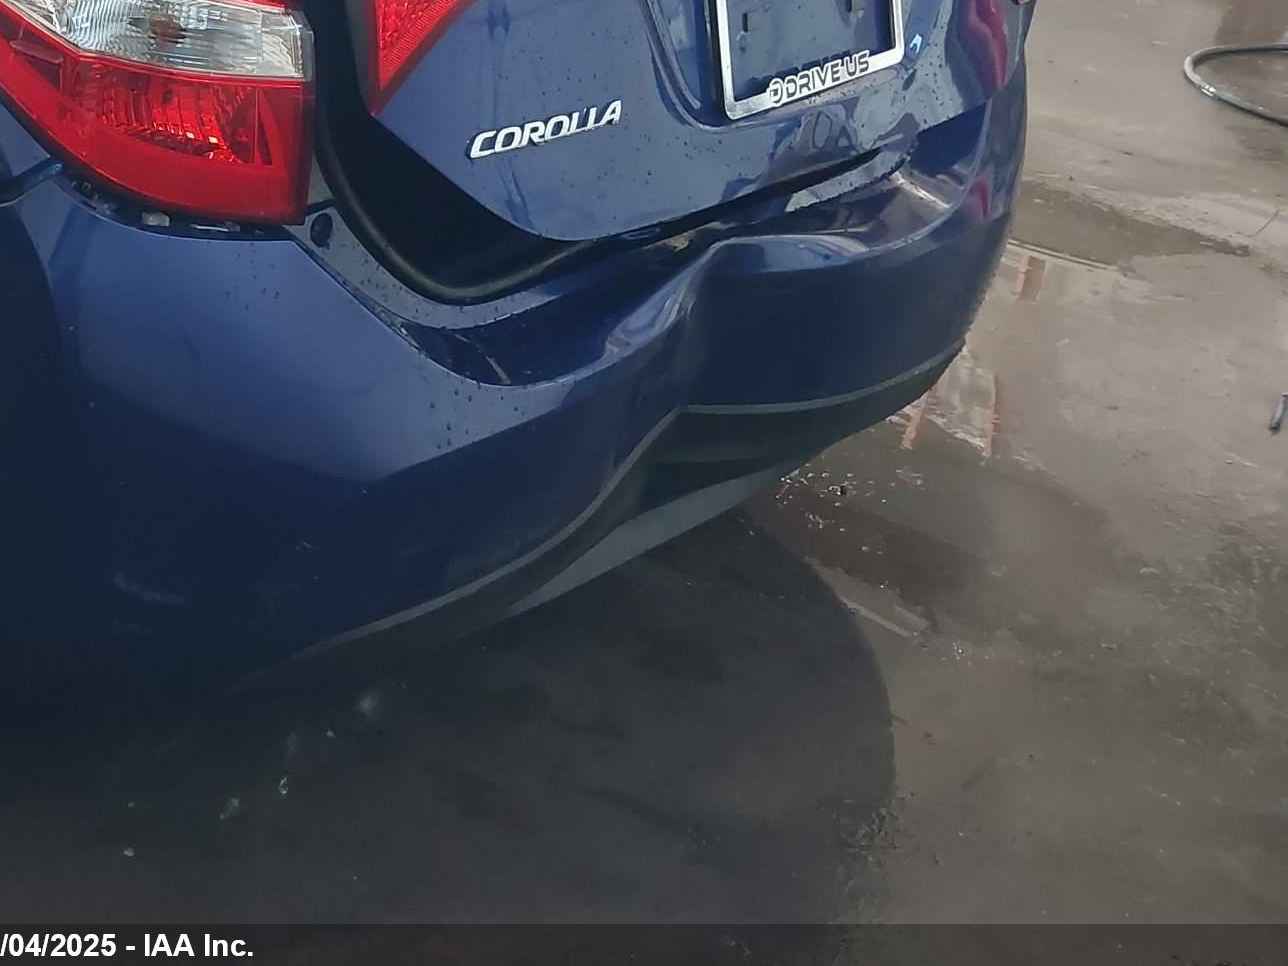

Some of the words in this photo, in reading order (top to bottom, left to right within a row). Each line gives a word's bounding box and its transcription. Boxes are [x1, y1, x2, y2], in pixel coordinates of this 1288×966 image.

[785, 61, 841, 99] DRIVE
[845, 52, 870, 77] US
[469, 99, 623, 159] COROLLA
